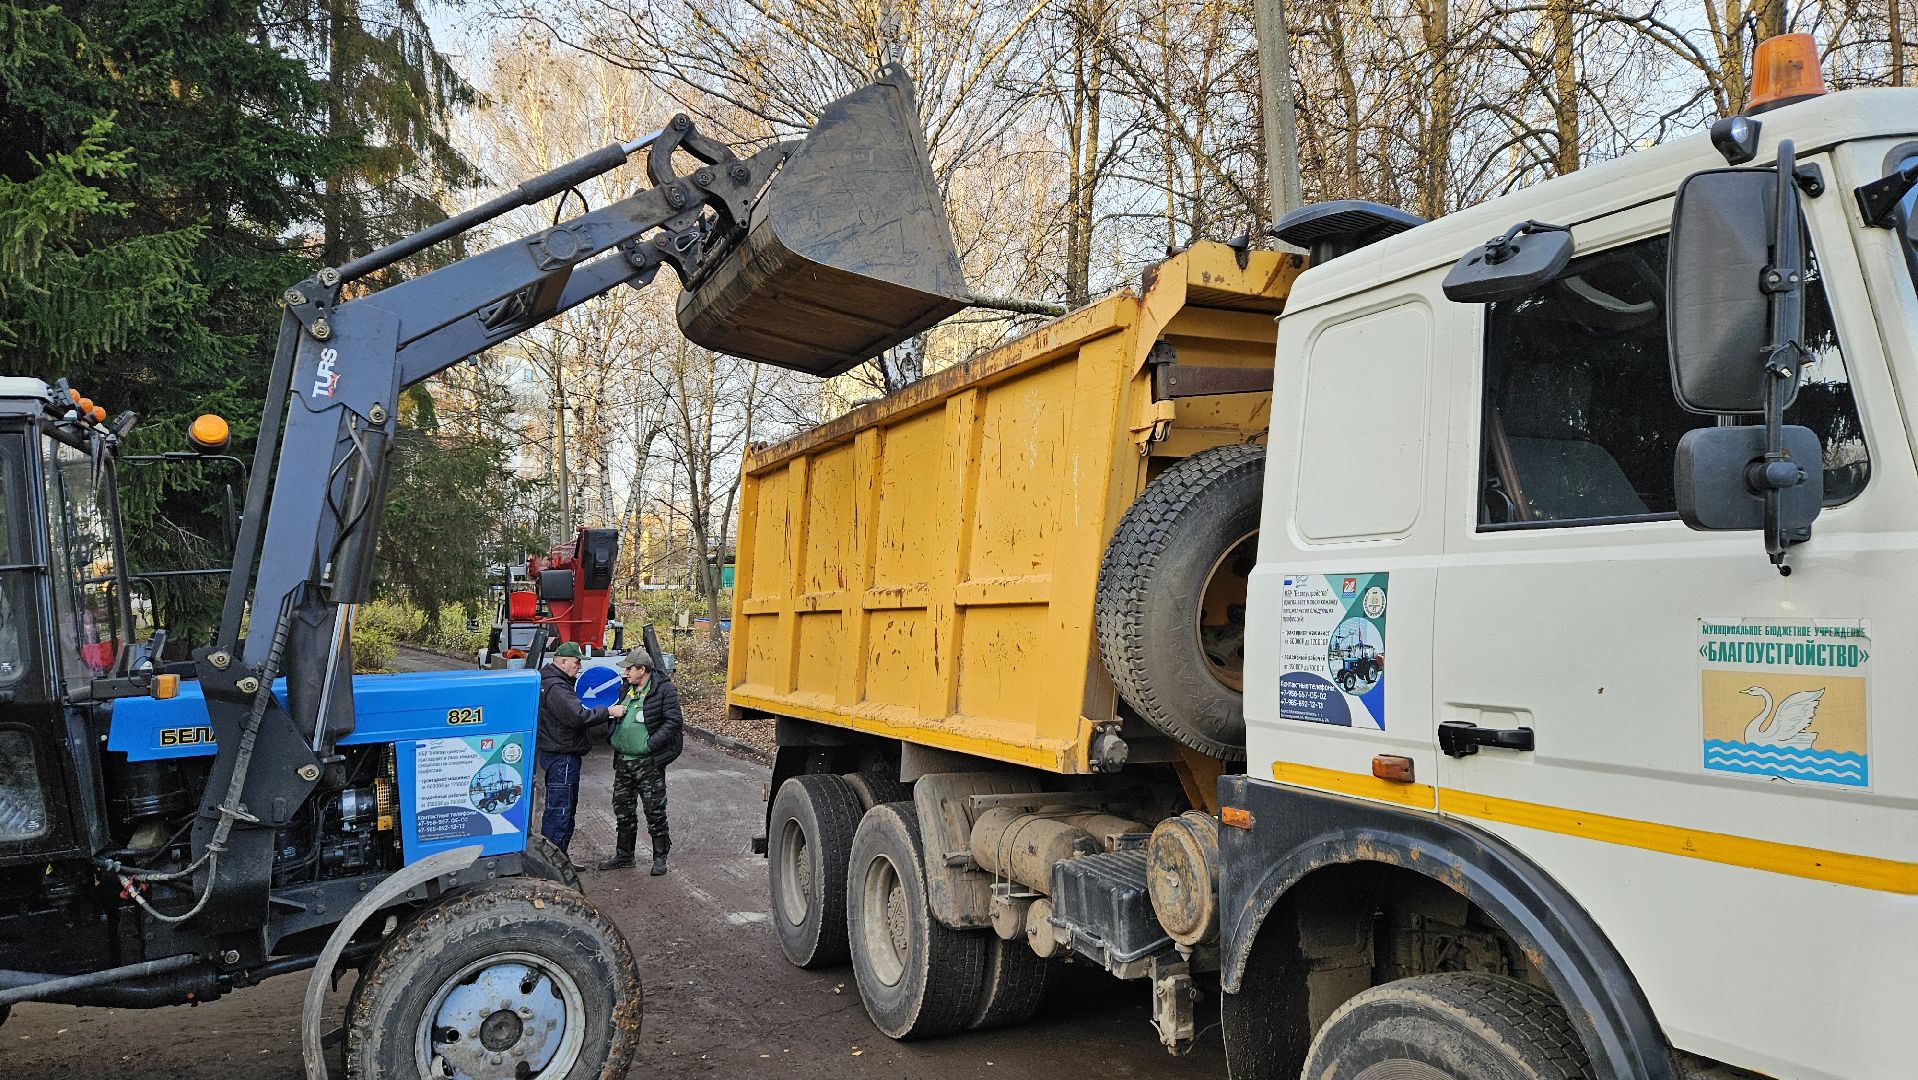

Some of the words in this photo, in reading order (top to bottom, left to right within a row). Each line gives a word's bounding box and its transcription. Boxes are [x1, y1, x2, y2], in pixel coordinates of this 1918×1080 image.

[312, 348, 337, 397] TURS
[1702, 624, 1762, 636] МУНИЦИПАЛЬНОЕ
[1765, 625, 1811, 638] БЮДЖЕТНОЕ
[1814, 626, 1866, 638] УЧРЕЖДЕНИЕ
[1699, 640, 1870, 668] «БЛАГОУСТРОЙСТВО»
[448, 706, 482, 725] 82.1
